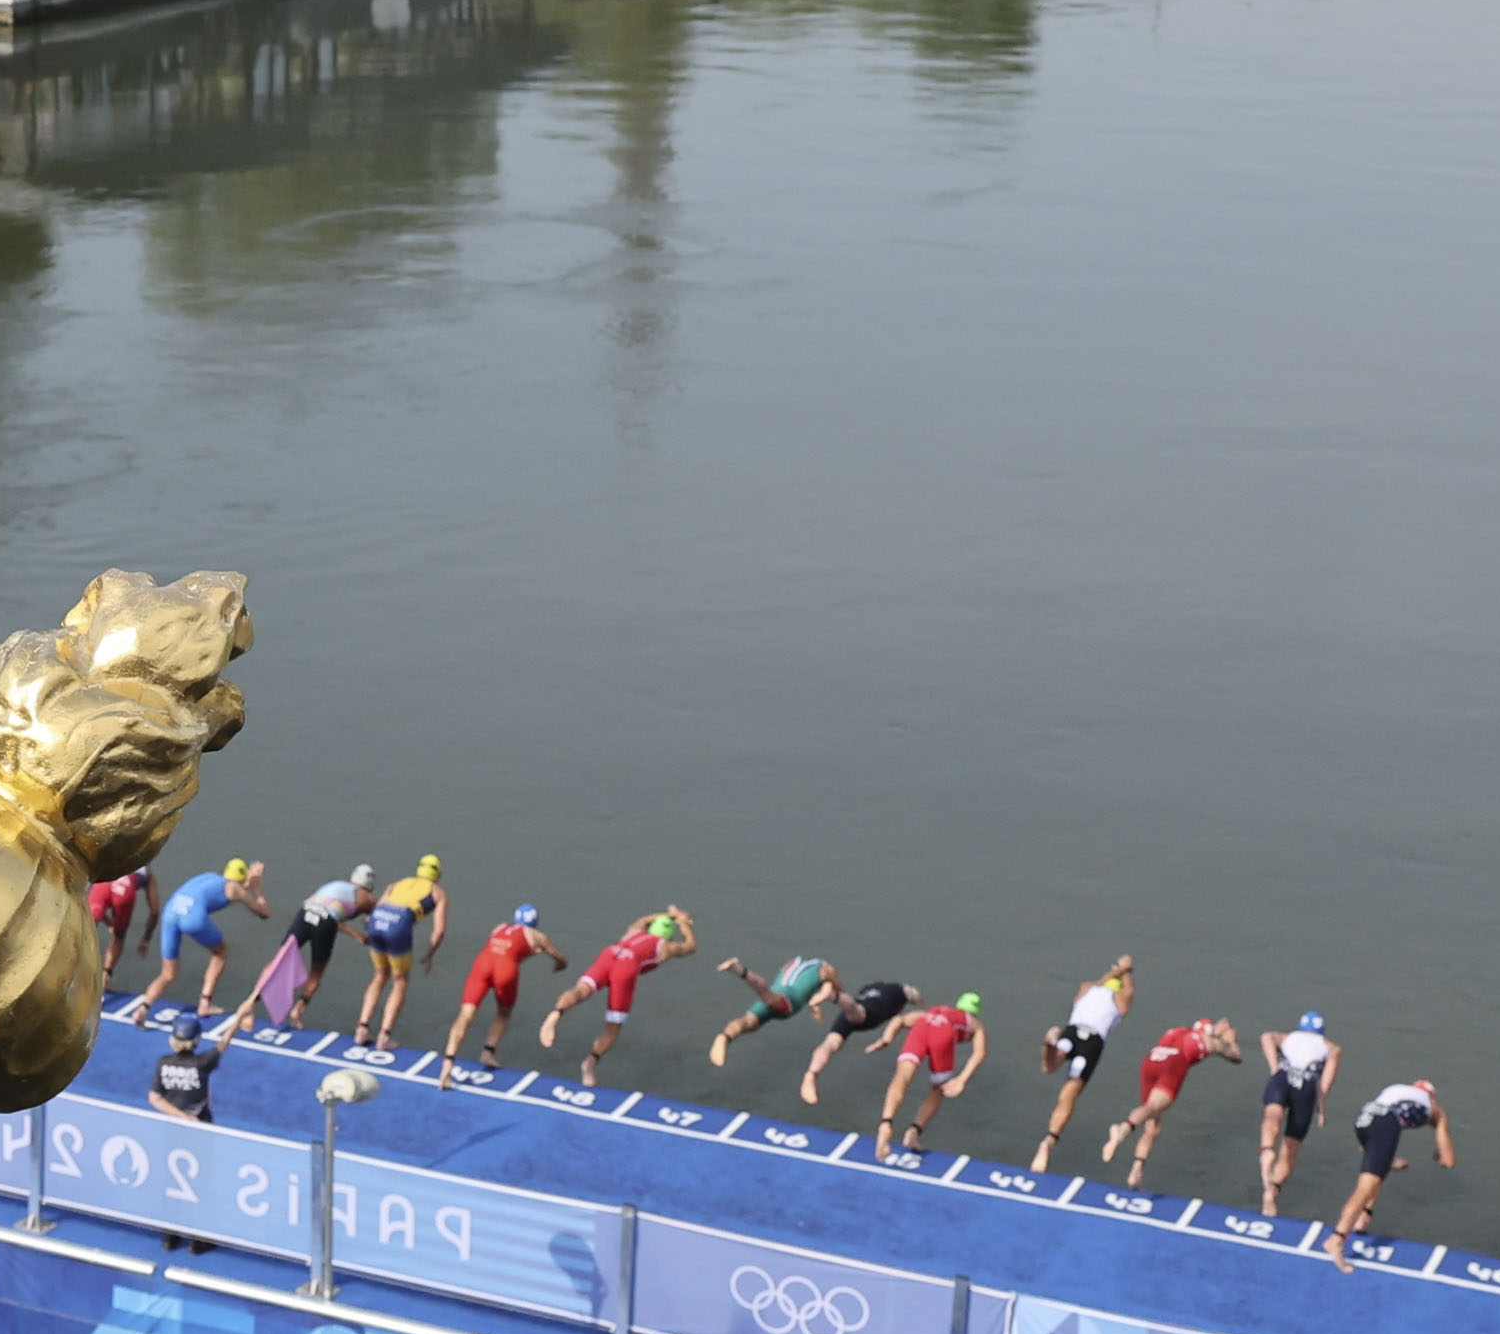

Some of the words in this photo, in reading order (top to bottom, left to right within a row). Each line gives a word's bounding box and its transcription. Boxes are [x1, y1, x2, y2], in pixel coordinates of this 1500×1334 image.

[253, 1028, 292, 1046] 51
[342, 1045, 396, 1065] 50
[450, 1065, 494, 1085] 49
[552, 1085, 596, 1107] 48
[658, 1106, 703, 1127] 47
[764, 1127, 810, 1149] 46
[989, 1170, 1037, 1193] 44
[1104, 1192, 1154, 1215] 43
[1224, 1214, 1275, 1240] 42
[1351, 1240, 1395, 1263] 41
